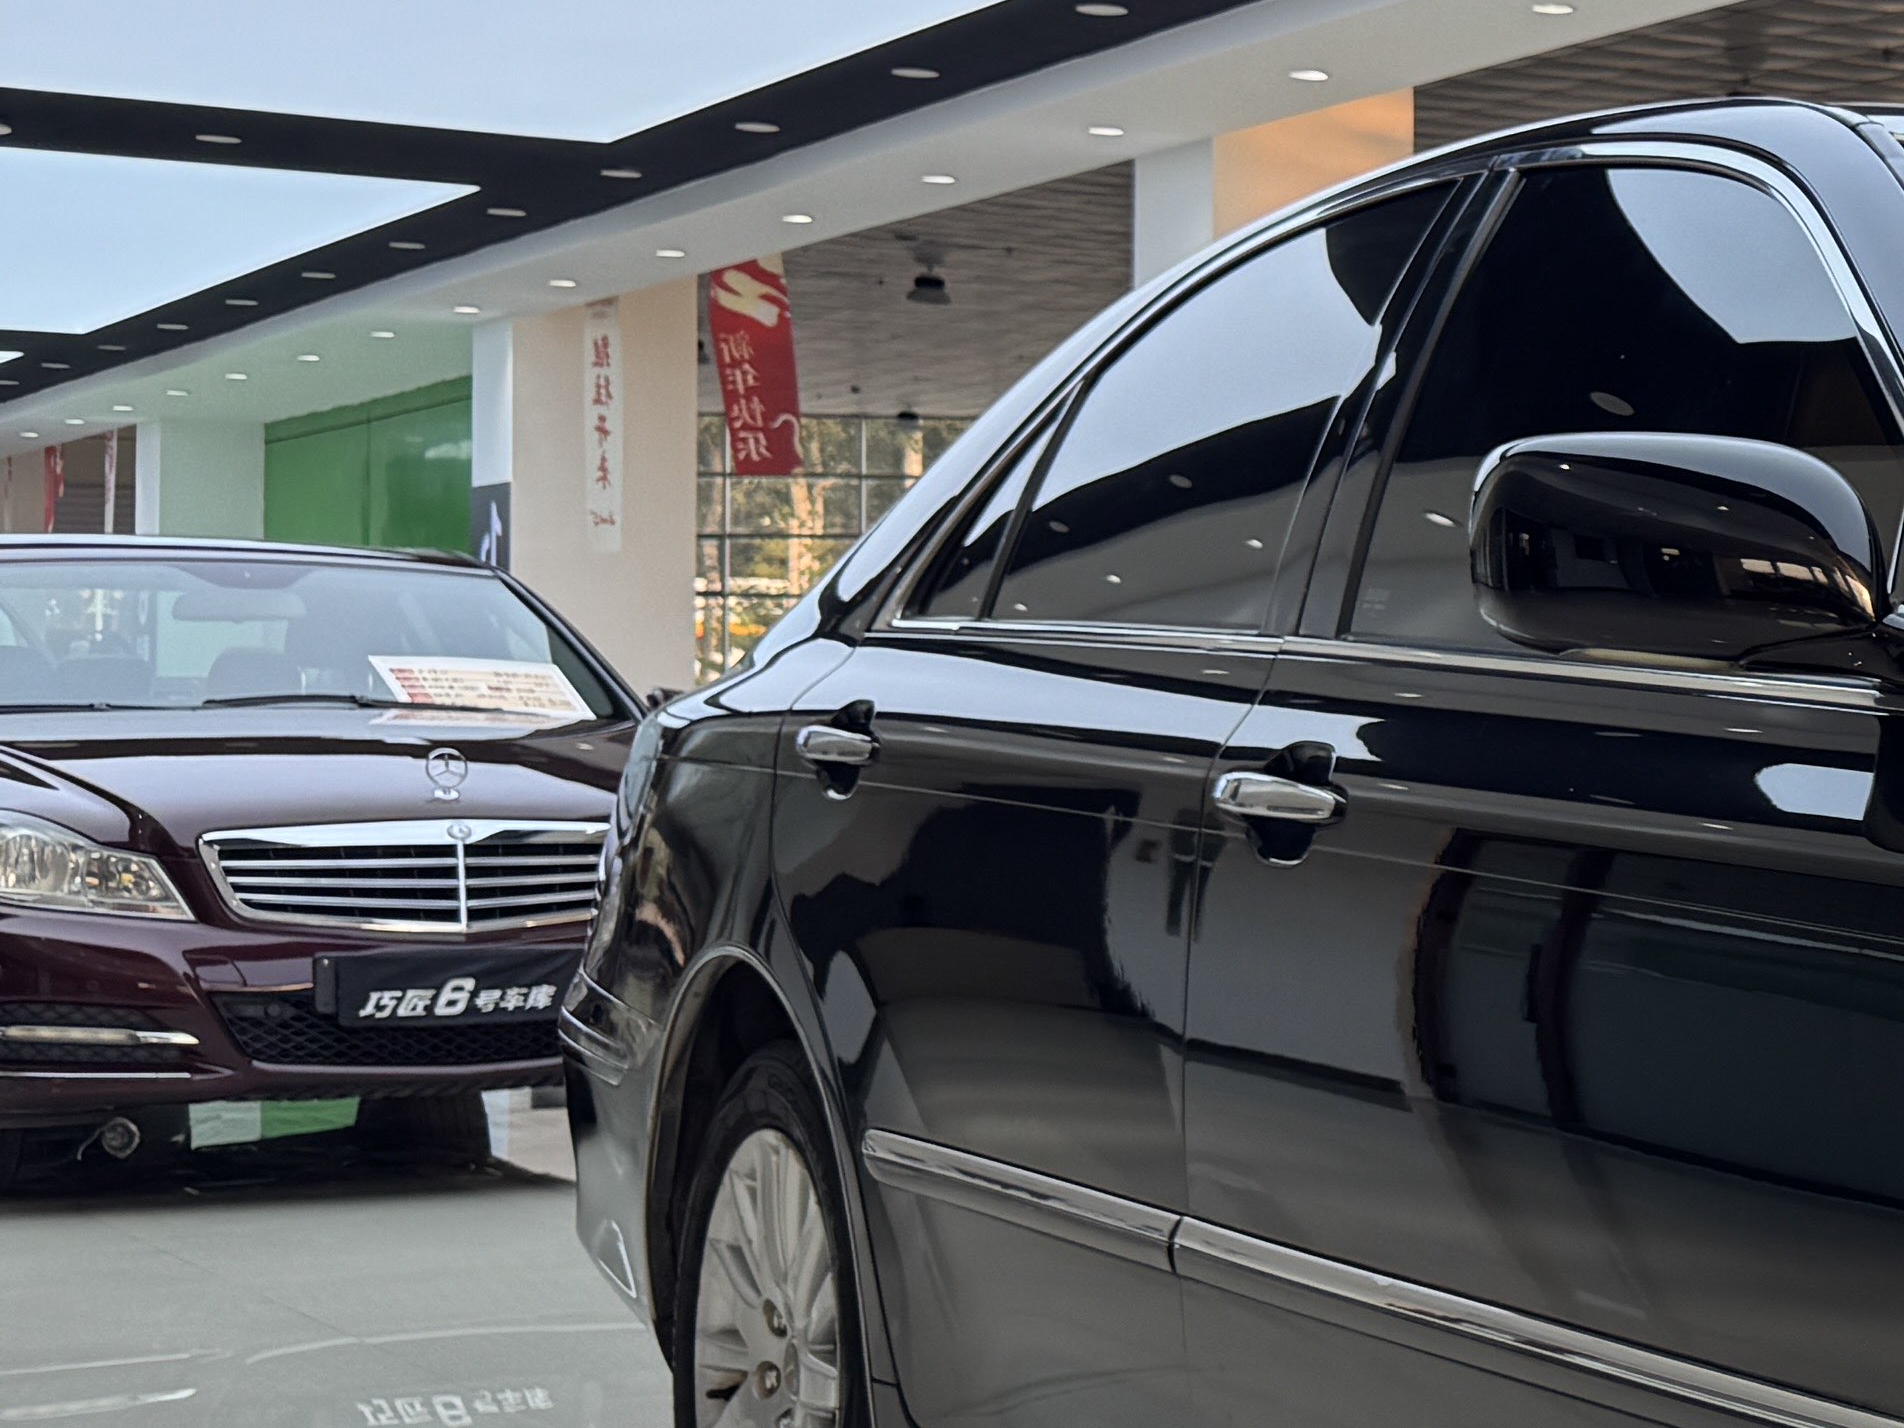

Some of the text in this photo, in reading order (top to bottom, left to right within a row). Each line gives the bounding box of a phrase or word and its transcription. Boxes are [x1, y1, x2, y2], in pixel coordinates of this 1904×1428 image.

[358, 976, 558, 1019] 巧匠6号车库
